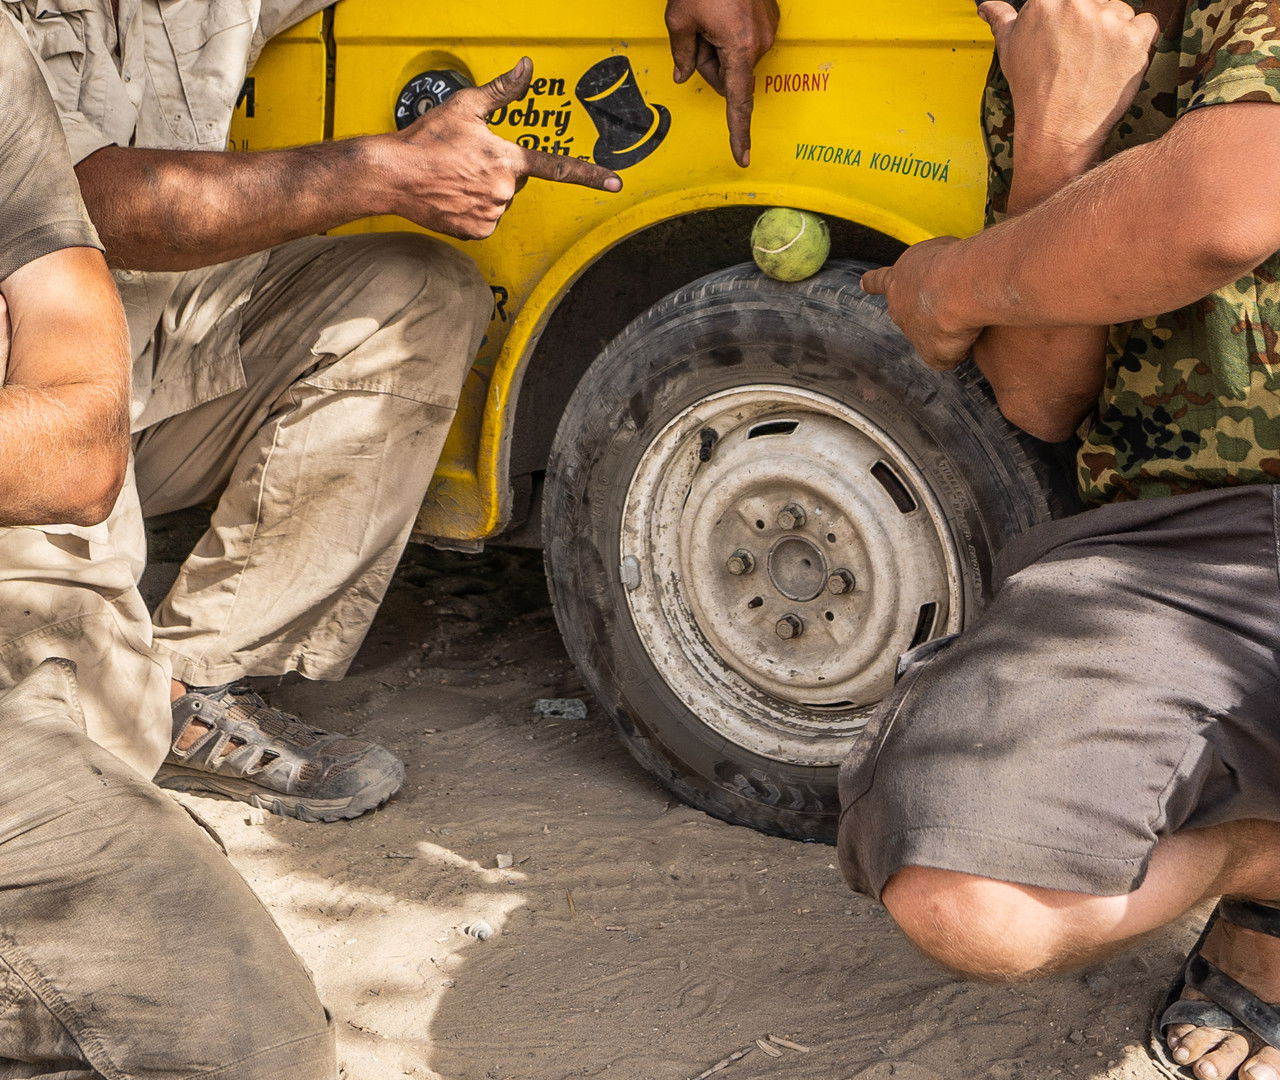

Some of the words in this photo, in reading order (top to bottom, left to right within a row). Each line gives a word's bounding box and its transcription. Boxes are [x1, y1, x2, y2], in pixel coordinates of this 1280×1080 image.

[397, 77, 451, 117] PETROL
[487, 98, 571, 136] Dobrý
[795, 143, 862, 167] VIKTORKA
[870, 153, 951, 183] KOHÚTOVÁ
